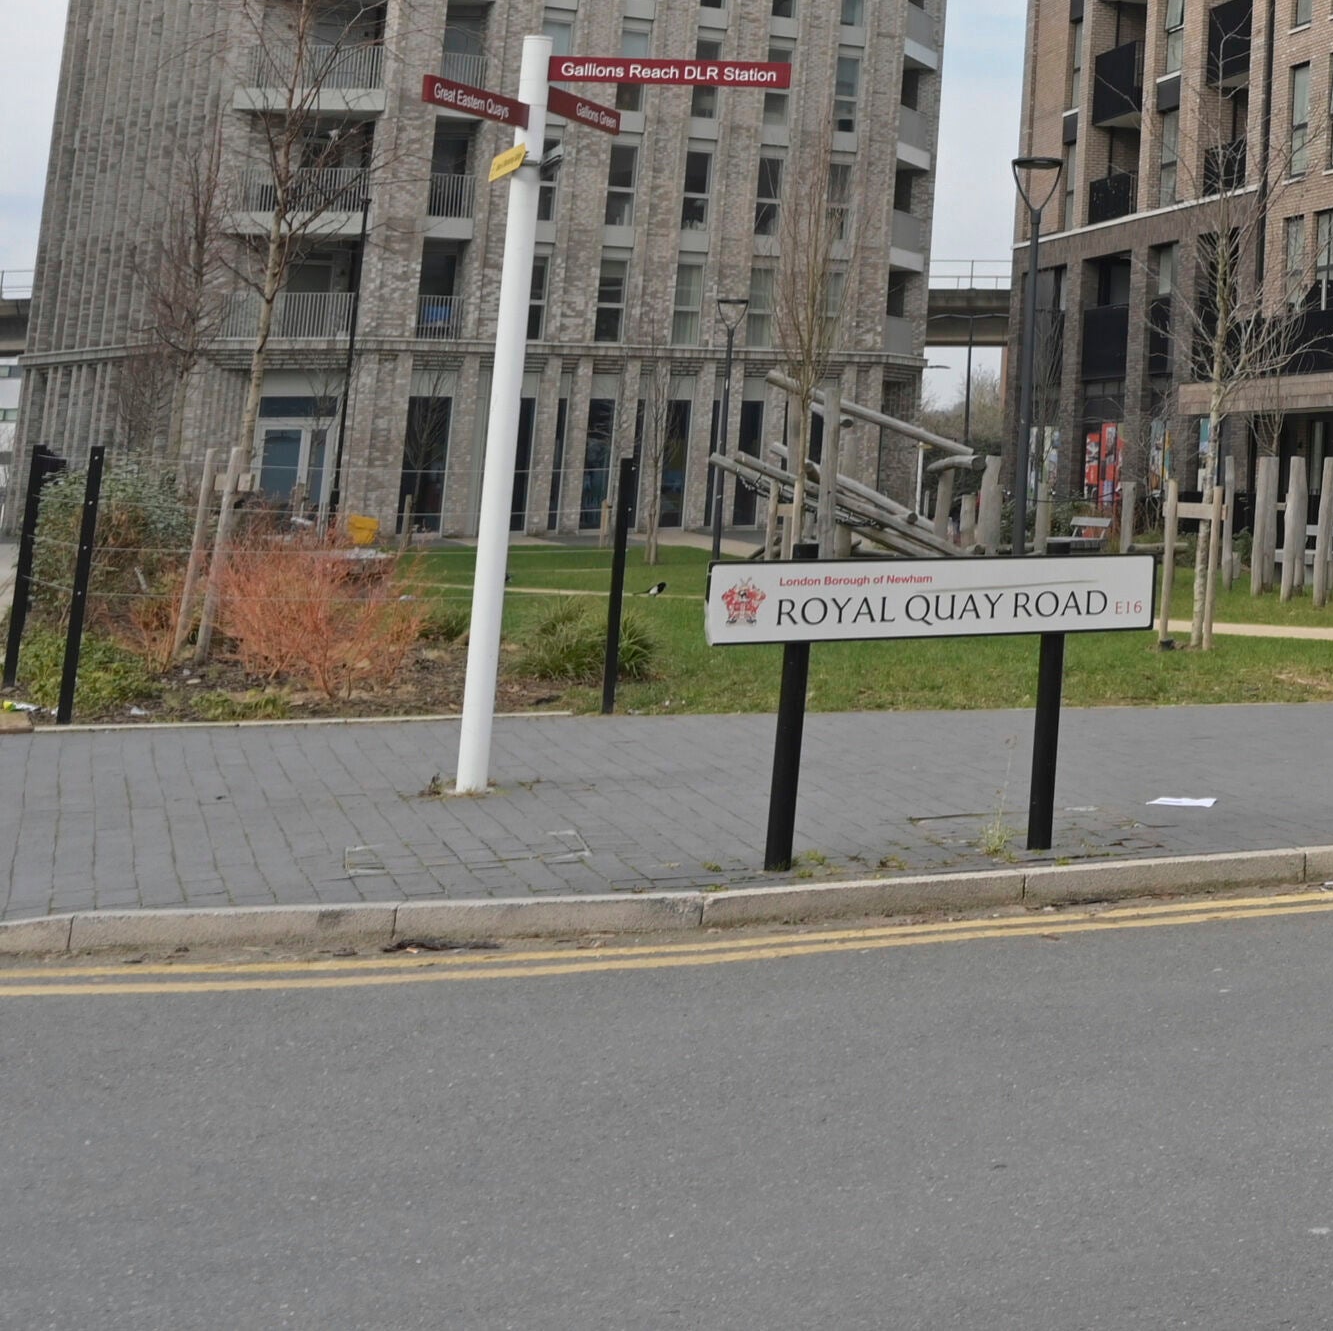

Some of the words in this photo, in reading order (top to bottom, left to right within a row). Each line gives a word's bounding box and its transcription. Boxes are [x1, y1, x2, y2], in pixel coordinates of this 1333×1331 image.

[561, 62, 625, 78] Gallions
[629, 64, 680, 79] Reach
[684, 66, 719, 80] DLR
[723, 67, 777, 82] Station
[433, 82, 456, 103] Great
[456, 89, 486, 111] Eastern
[486, 98, 510, 120] Quays
[576, 102, 599, 123] Gallions
[600, 110, 617, 128] Green
[779, 576, 821, 587] London
[824, 575, 871, 587] Borough
[873, 575, 885, 585] of
[886, 574, 933, 584] Newham
[776, 596, 896, 626] ROYAL
[904, 592, 1004, 626] QUAY
[1012, 590, 1108, 619] ROAD
[1115, 600, 1143, 615] E16
